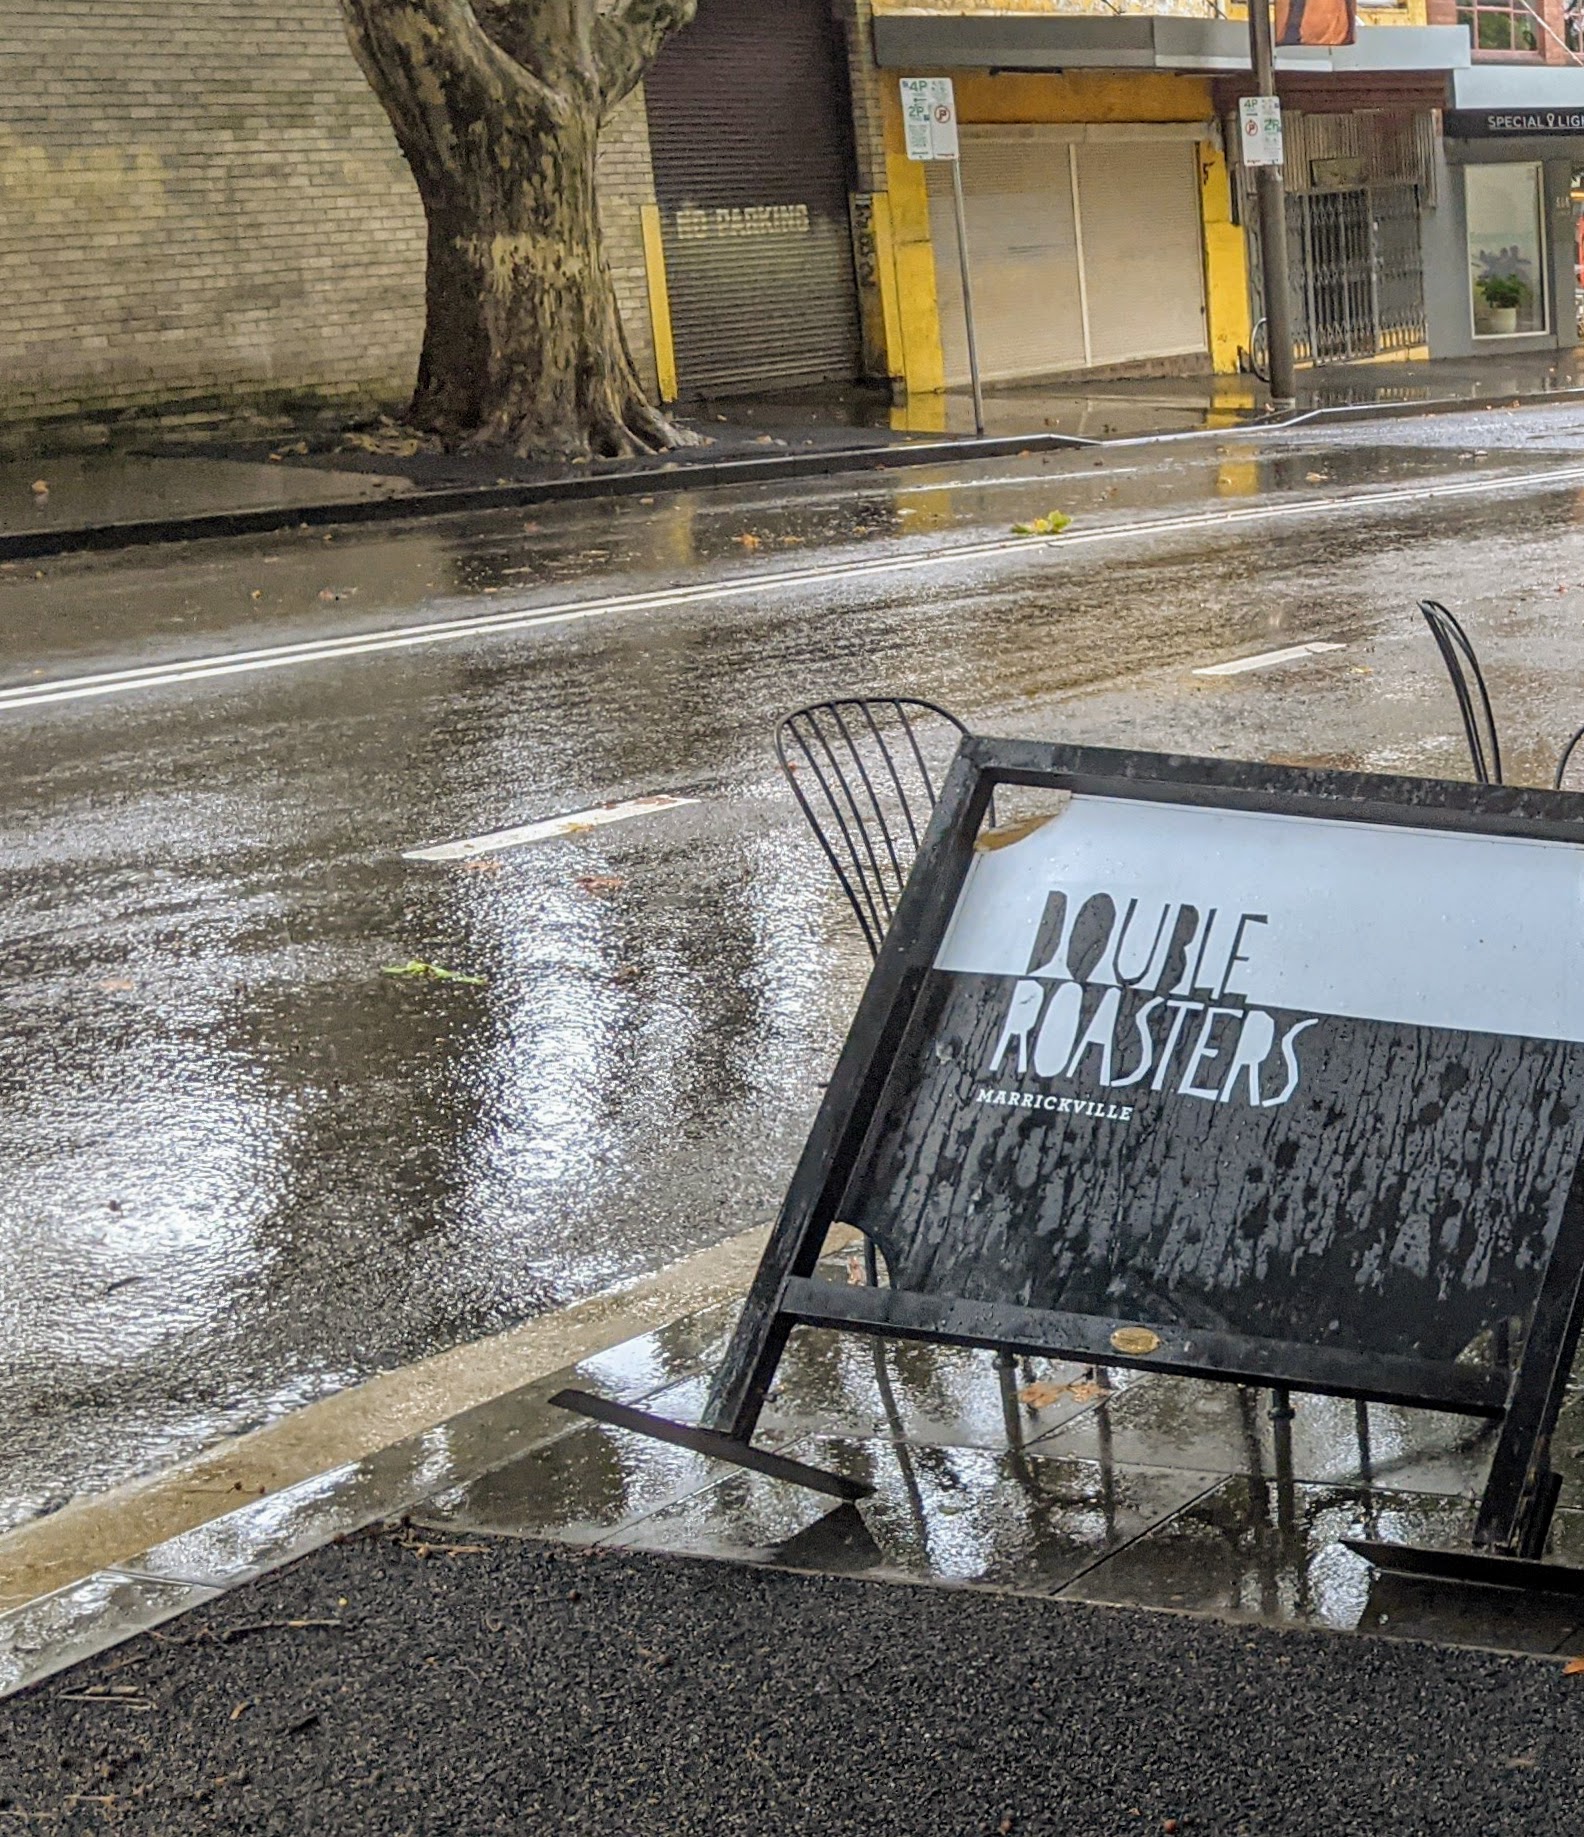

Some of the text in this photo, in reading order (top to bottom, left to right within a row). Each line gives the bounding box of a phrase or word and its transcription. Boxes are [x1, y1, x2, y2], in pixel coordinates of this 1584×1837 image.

[909, 80, 928, 92] 4P
[908, 105, 924, 117] 2P
[1244, 98, 1258, 108] 4P
[1488, 114, 1545, 128] SPECIAL
[677, 203, 810, 239] NO PARKING
[1026, 889, 1269, 1004] DOUBLE
[989, 978, 1320, 1108] ROASTERS
[976, 1088, 1134, 1121] MARRICKVILLE
